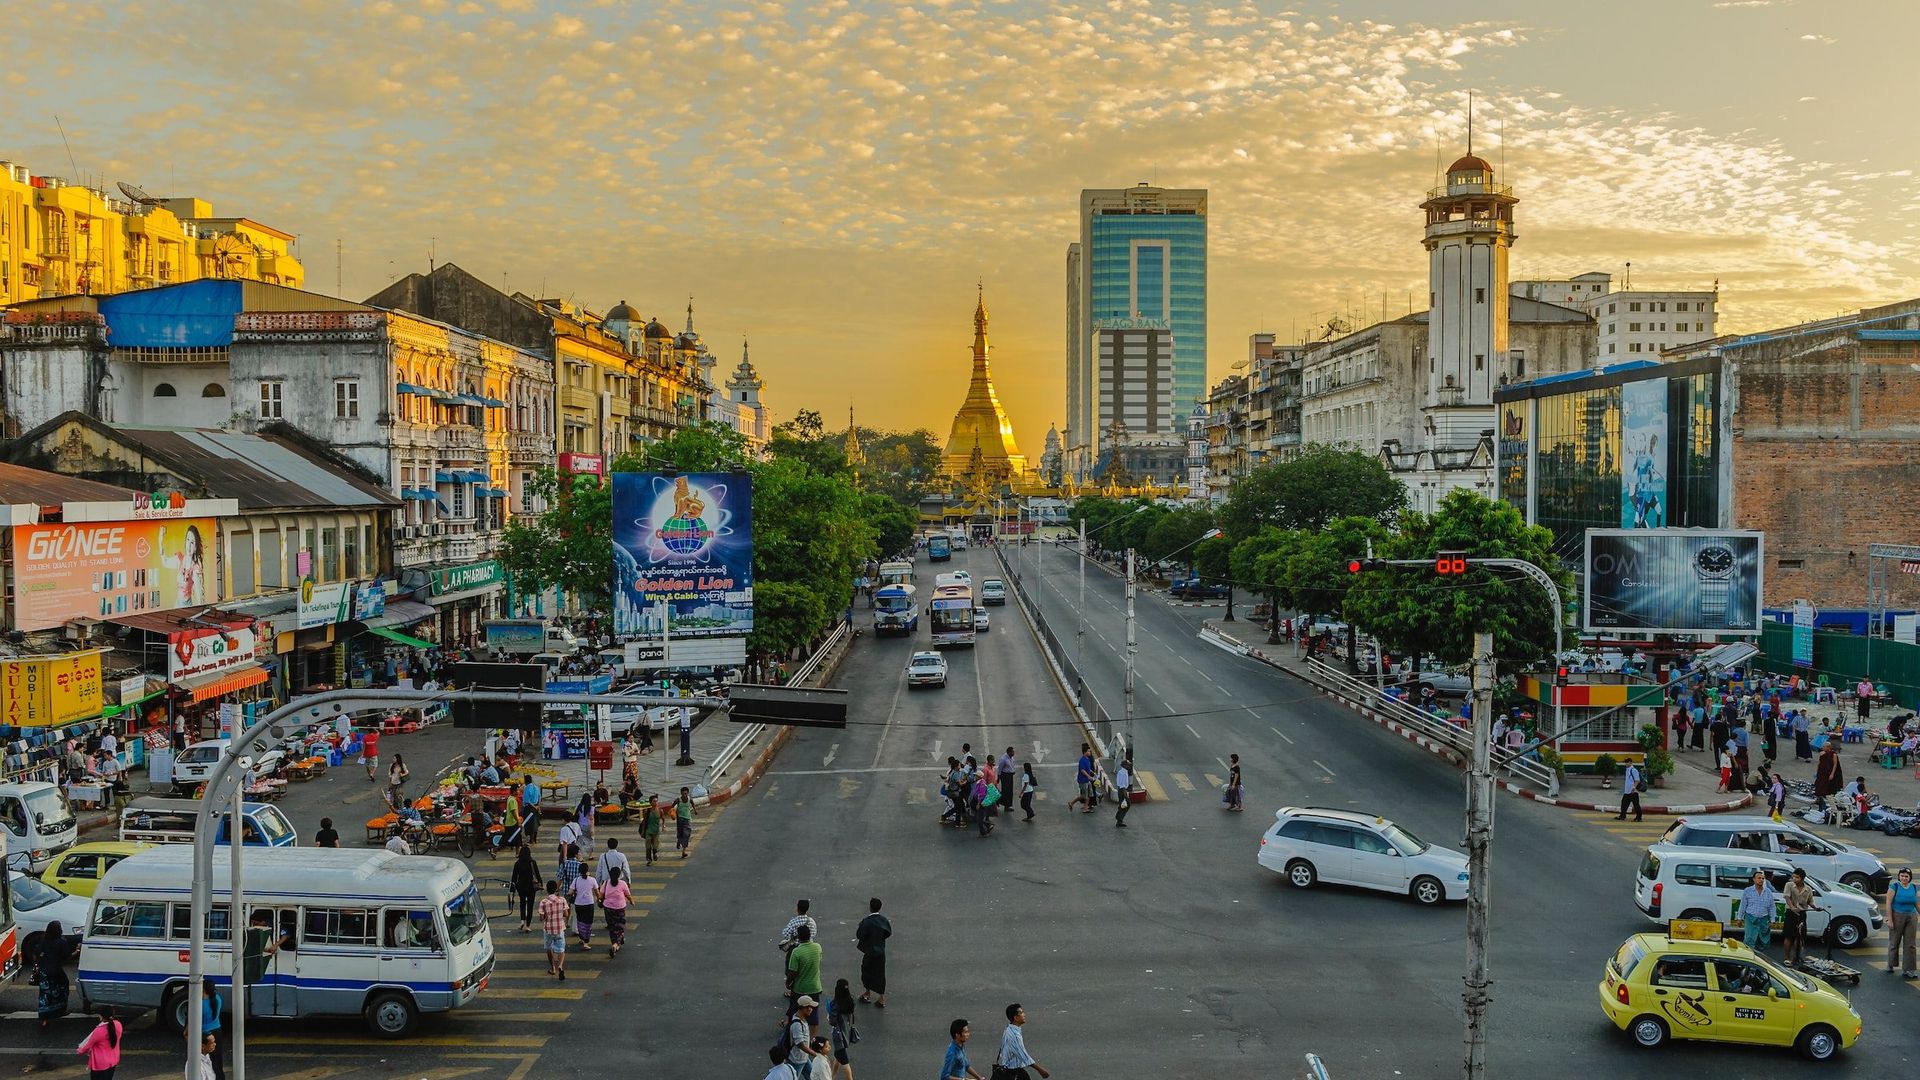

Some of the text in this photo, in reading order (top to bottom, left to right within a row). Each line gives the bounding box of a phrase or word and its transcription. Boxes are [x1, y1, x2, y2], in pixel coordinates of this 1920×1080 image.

[1112, 319, 1168, 328] AGD BANK
[151, 492, 168, 509] Co
[169, 491, 187, 509] Mo
[135, 511, 145, 519] Sale
[151, 509, 168, 518] Service
[168, 509, 184, 518] Center
[655, 529, 691, 539] Golden
[80, 560, 88, 568] TO
[90, 558, 107, 567] STAND
[462, 565, 495, 584] PHARMACY
[635, 576, 734, 592] Golden Lion
[645, 592, 666, 601] Wire
[666, 593, 673, 601] &
[673, 592, 699, 600] Cable
[212, 639, 225, 655] Co
[8, 661, 21, 726] SULAY
[27, 665, 37, 719] MOBILE
